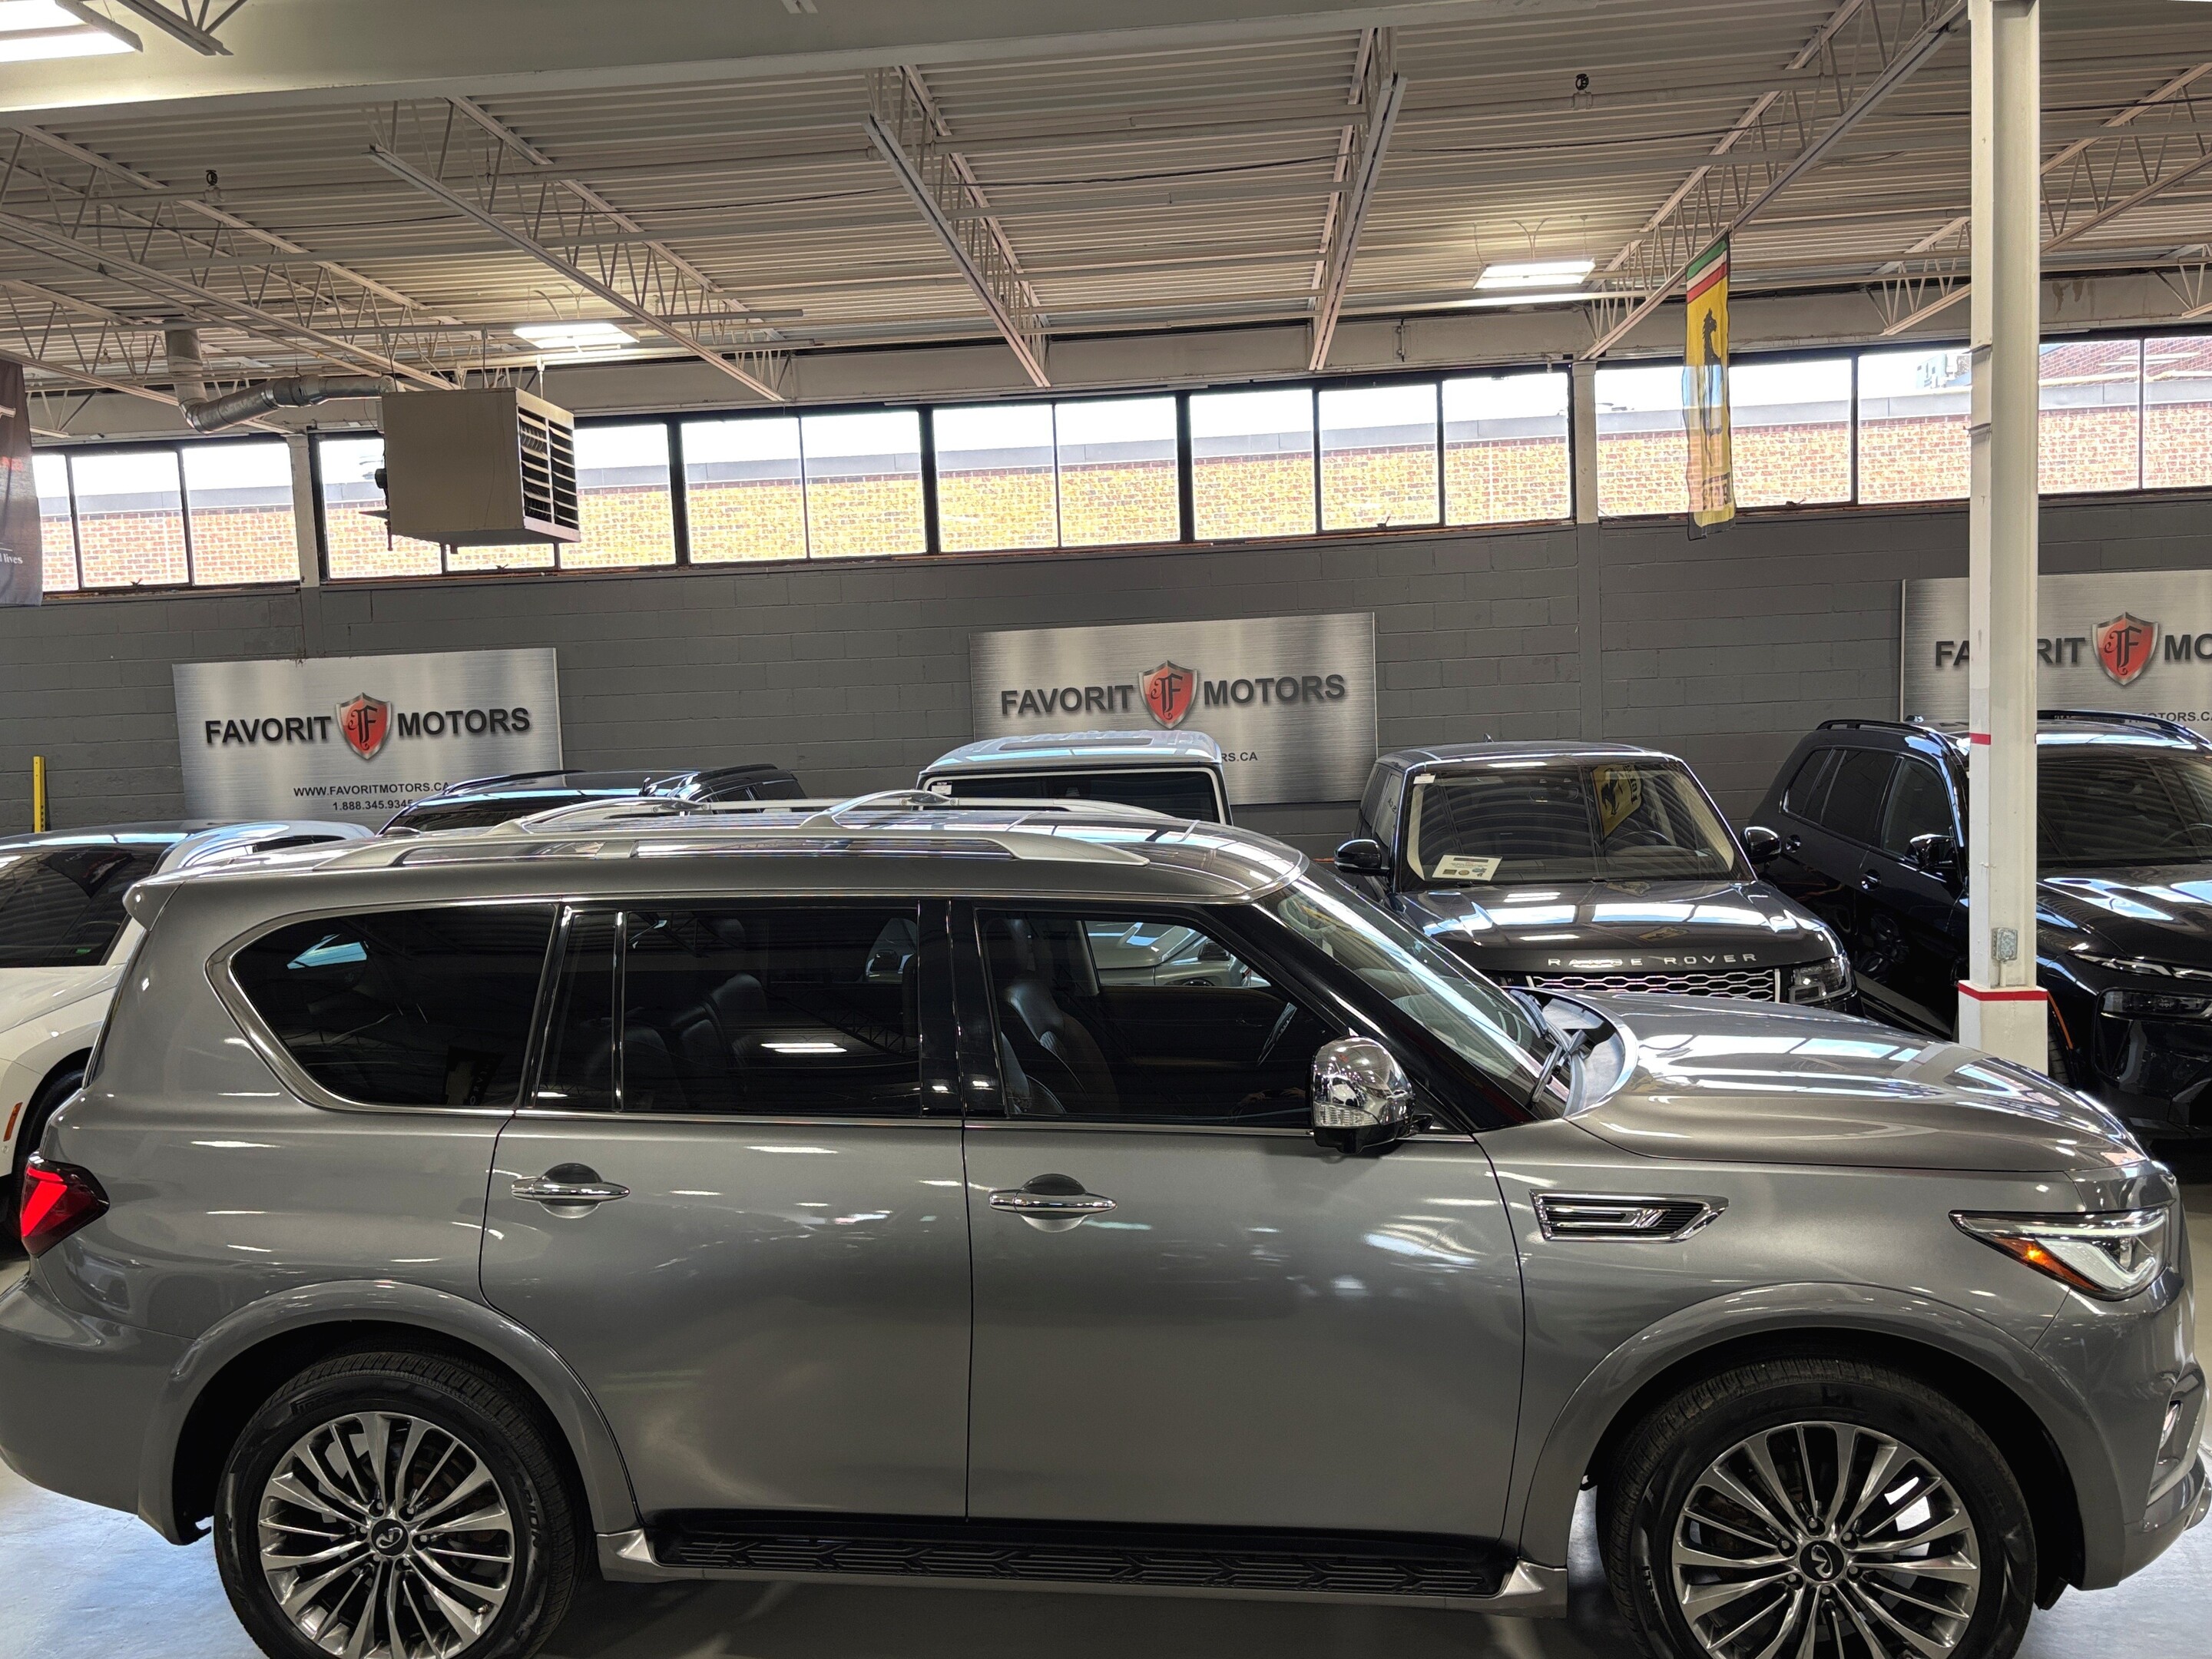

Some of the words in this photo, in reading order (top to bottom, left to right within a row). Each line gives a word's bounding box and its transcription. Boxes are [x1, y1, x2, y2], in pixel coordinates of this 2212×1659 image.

[3, 553, 23, 565] lives
[1935, 637, 2086, 667] FARIT
[1001, 684, 1134, 715] FAVORIT
[1204, 674, 1346, 706] MOTORS
[204, 715, 332, 744] FAVORIT
[397, 707, 531, 737] MOTORS
[293, 781, 450, 797] WWW.FAVORITMOTORS.CA
[1664, 953, 1757, 965] ROVER
